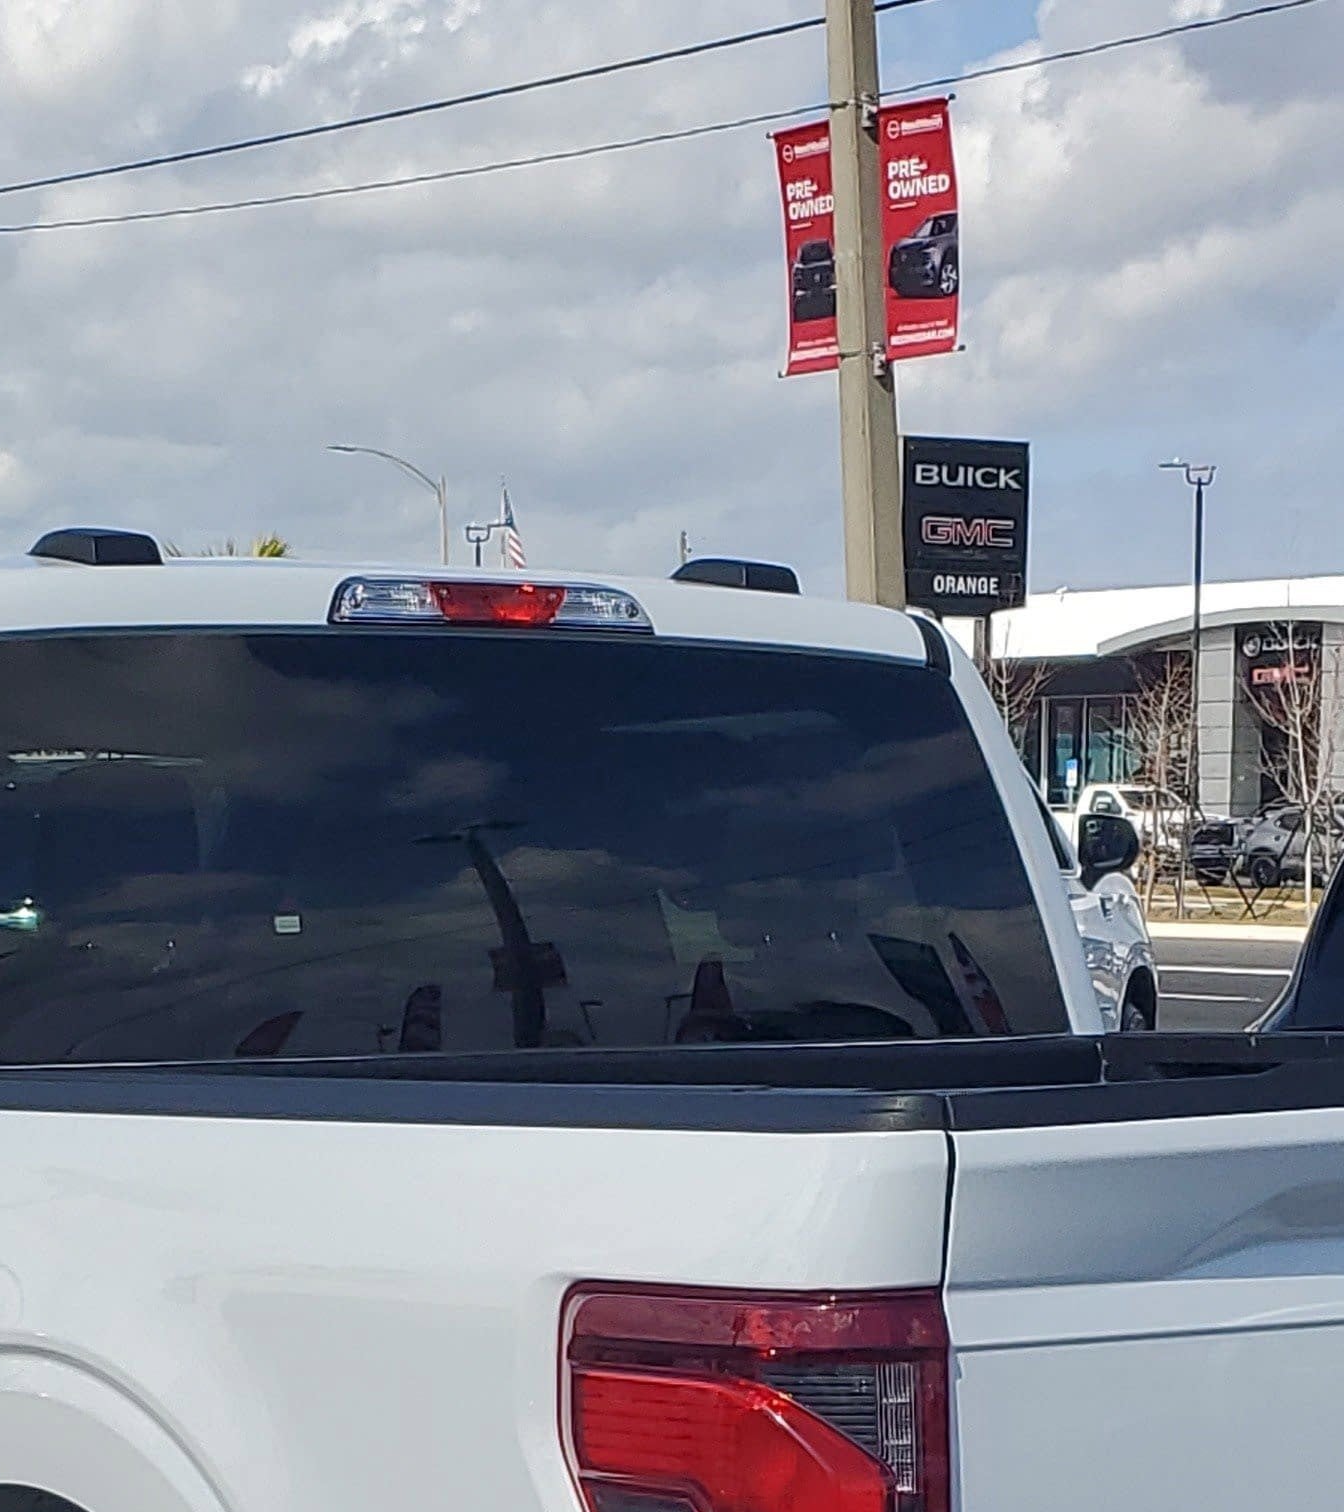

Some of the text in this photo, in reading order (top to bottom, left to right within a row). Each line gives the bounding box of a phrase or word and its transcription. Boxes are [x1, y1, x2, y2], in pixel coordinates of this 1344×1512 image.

[887, 156, 928, 180] PRE-
[785, 179, 818, 201] PRE-
[887, 173, 950, 200] OWNED
[788, 195, 834, 220] OWNED
[914, 463, 1022, 490] BUICK
[921, 515, 1015, 548] GMC
[932, 574, 1000, 596] ORANGE
